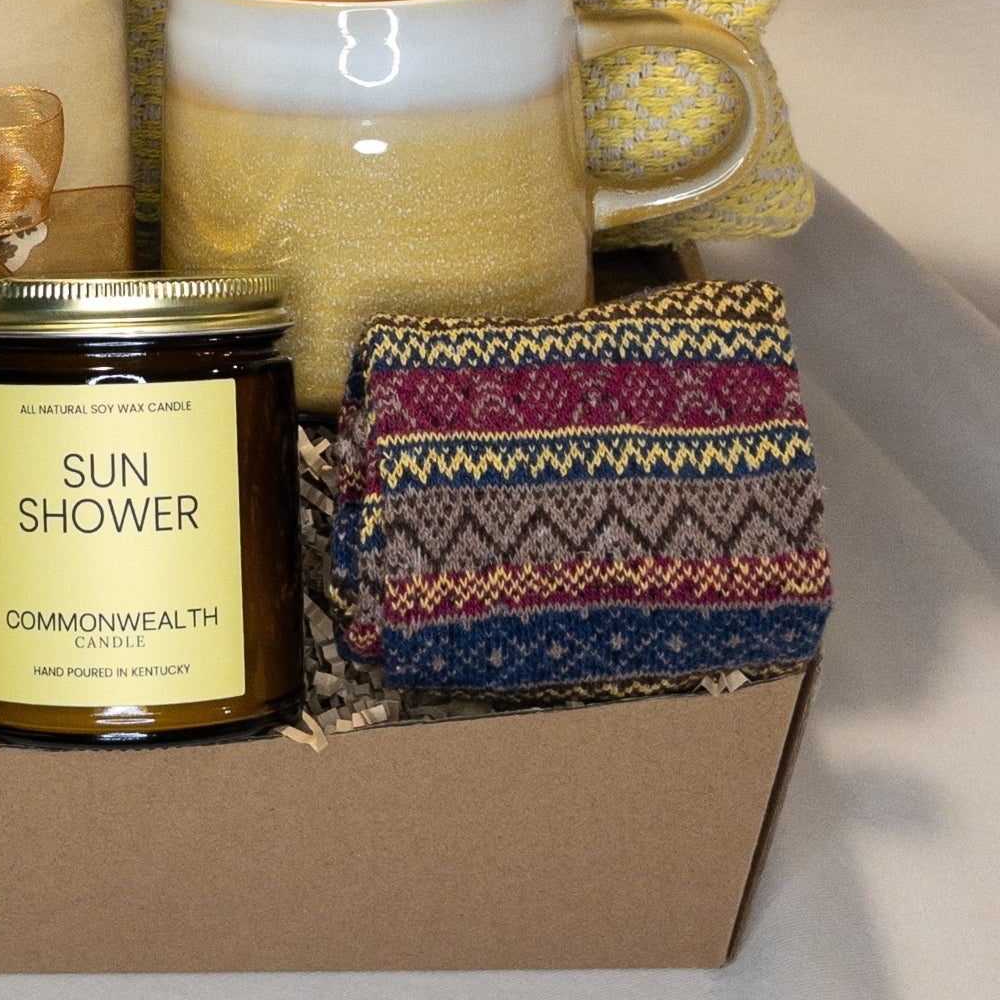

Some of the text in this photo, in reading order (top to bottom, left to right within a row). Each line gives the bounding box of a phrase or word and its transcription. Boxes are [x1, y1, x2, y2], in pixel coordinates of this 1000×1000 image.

[20, 400, 192, 416] ALL NATURAL SOY WAX CANDLE
[63, 451, 149, 489] SUN
[18, 494, 199, 534] SHOWER
[6, 606, 219, 632] COMMONWEALTH
[74, 635, 146, 649] CANDLE
[33, 663, 191, 678] HAND POURED IN KENTUCKY
